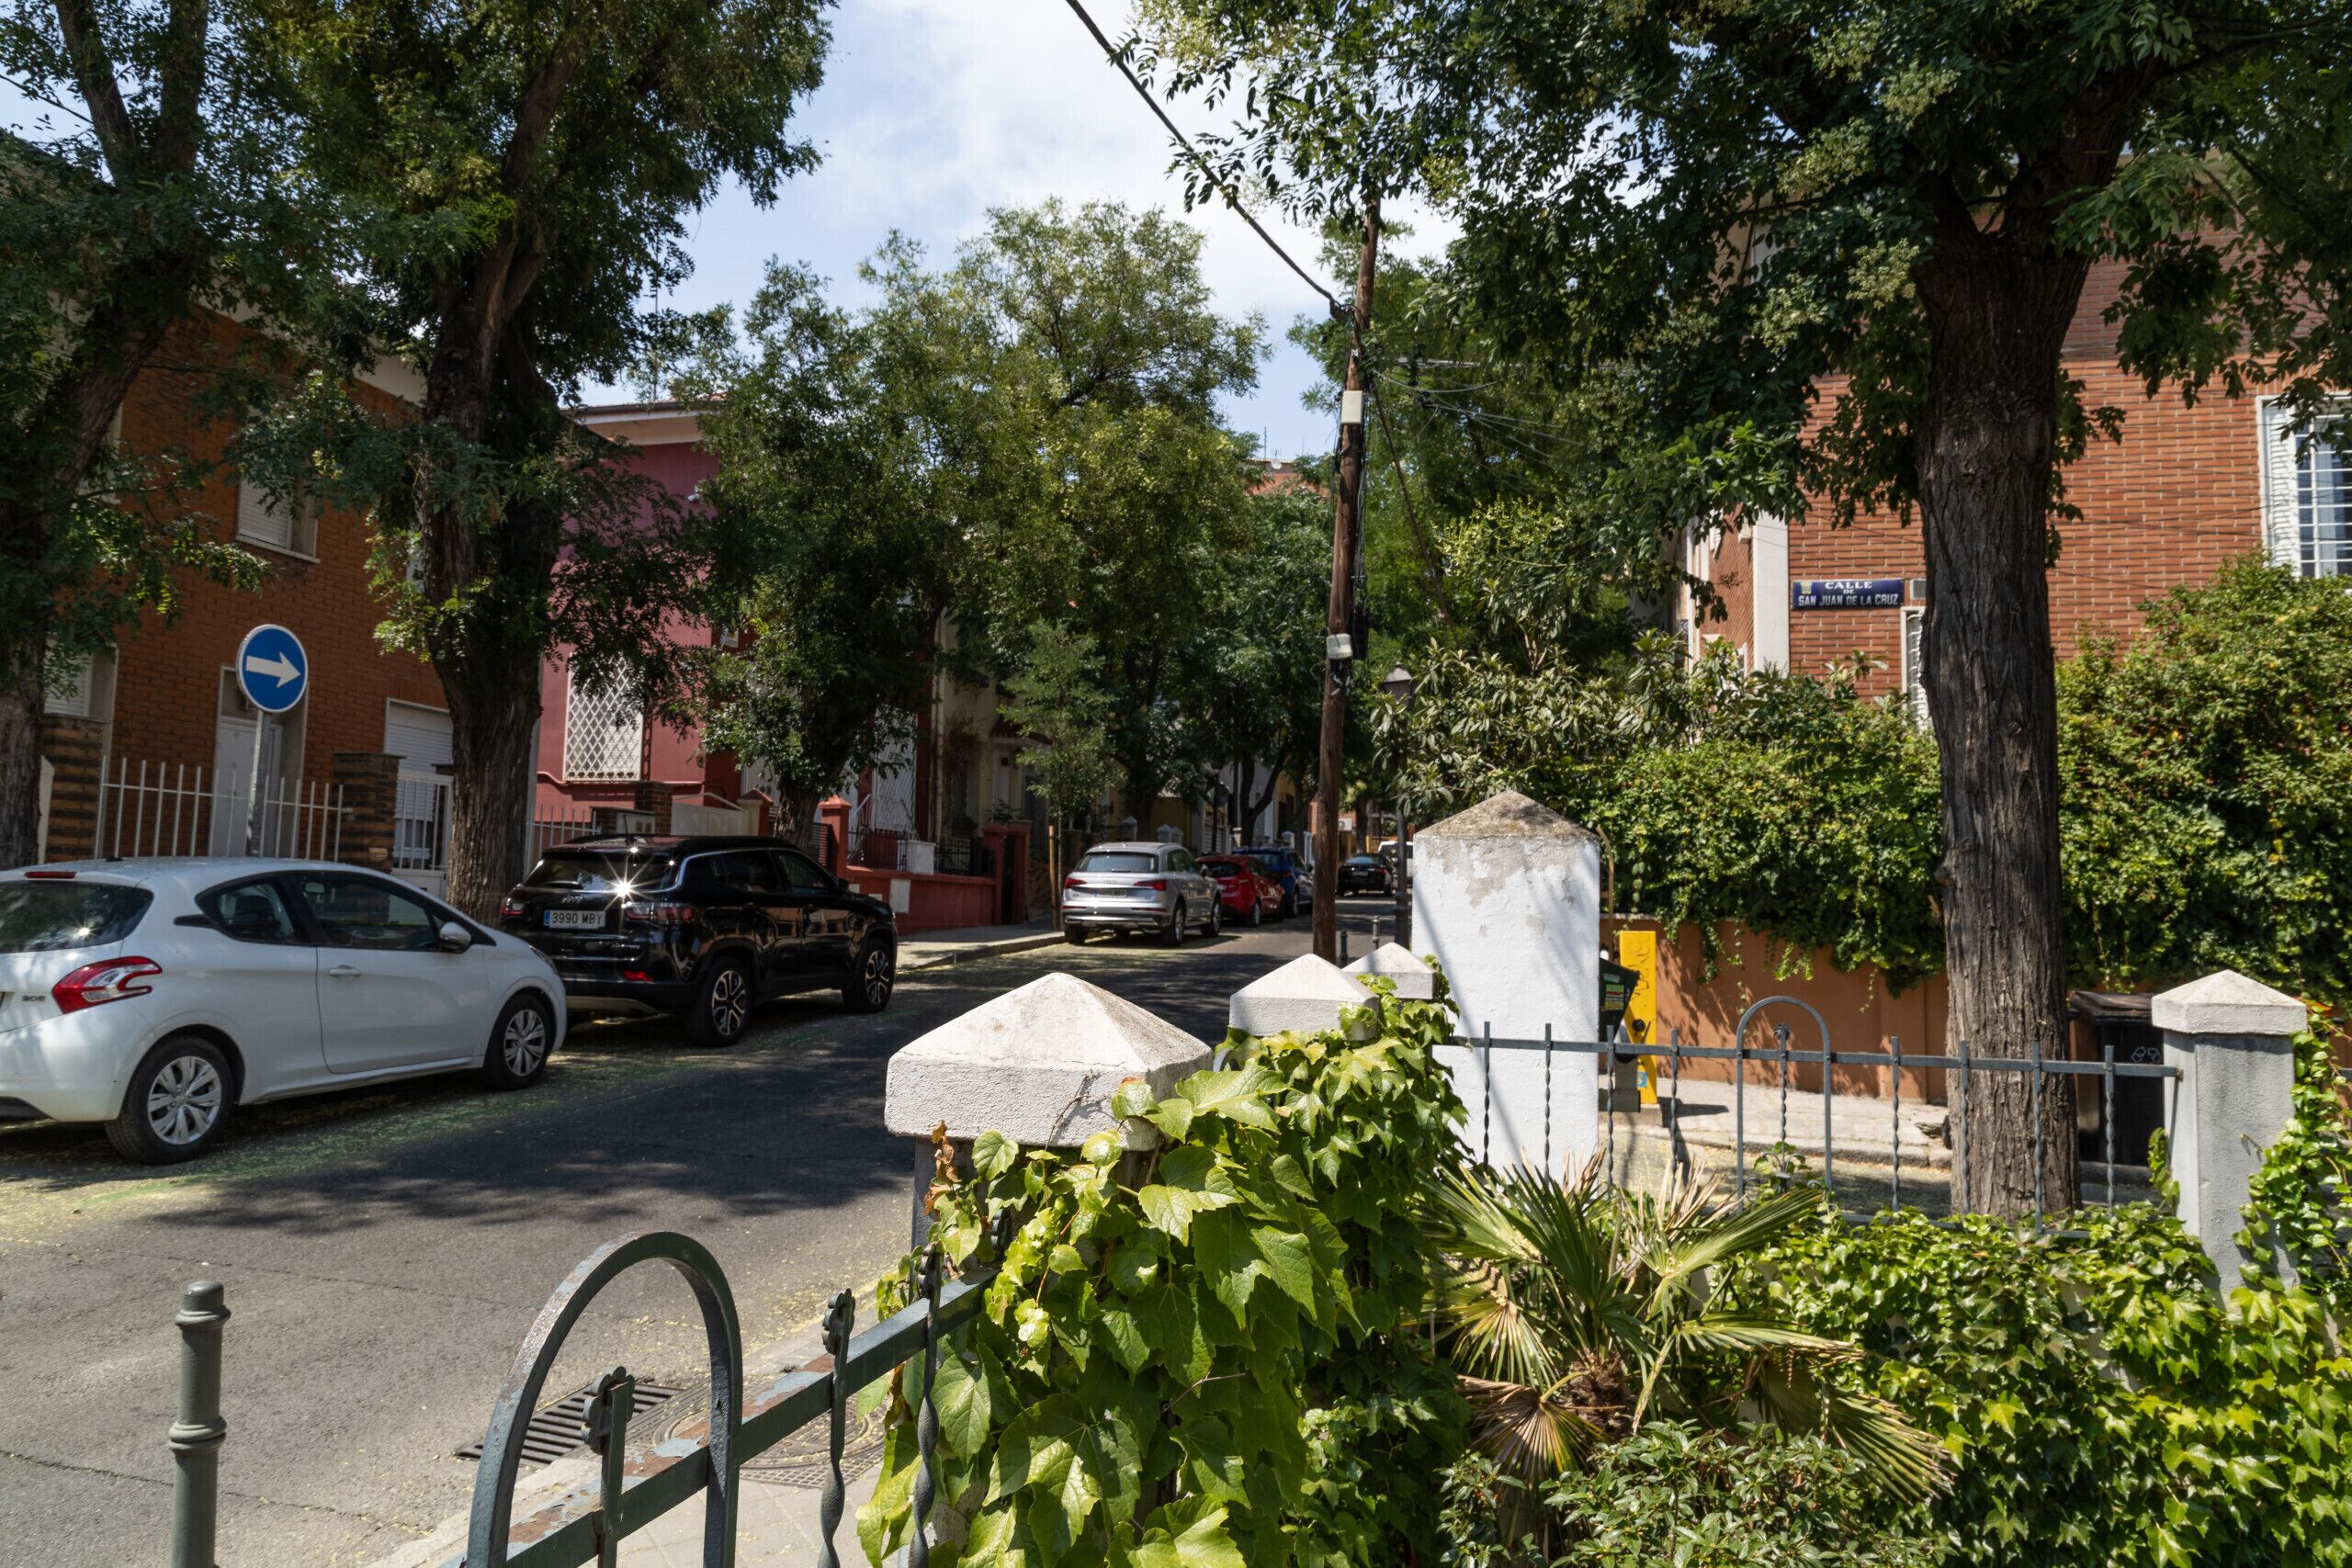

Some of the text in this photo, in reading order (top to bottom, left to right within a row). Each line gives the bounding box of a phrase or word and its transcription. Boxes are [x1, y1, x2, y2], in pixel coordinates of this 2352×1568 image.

[1798, 593, 1899, 606] SAN JUAN DE LA CRUZ
[552, 912, 579, 924] 3990
